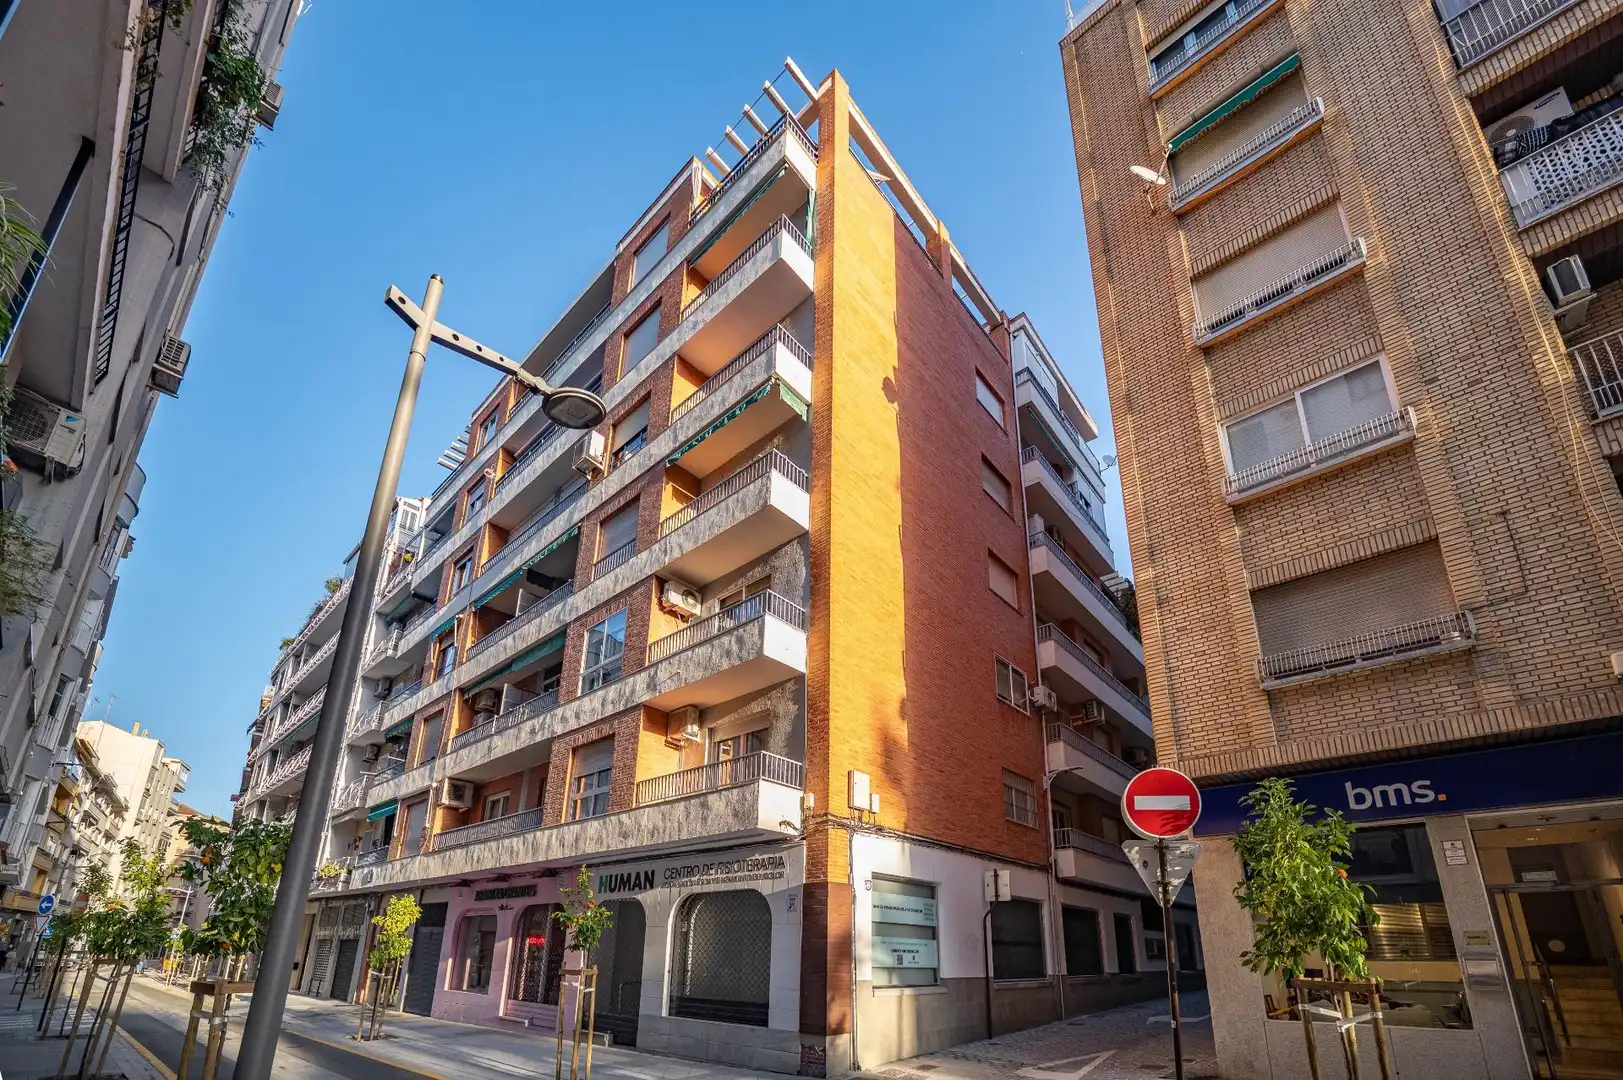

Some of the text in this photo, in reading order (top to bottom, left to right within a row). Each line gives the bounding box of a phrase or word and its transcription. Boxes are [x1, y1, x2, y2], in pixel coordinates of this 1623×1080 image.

[1345, 780, 1446, 810] bms.
[664, 855, 786, 880] CENTRO DE FISIOTERAPIA
[598, 869, 656, 894] HUMAN
